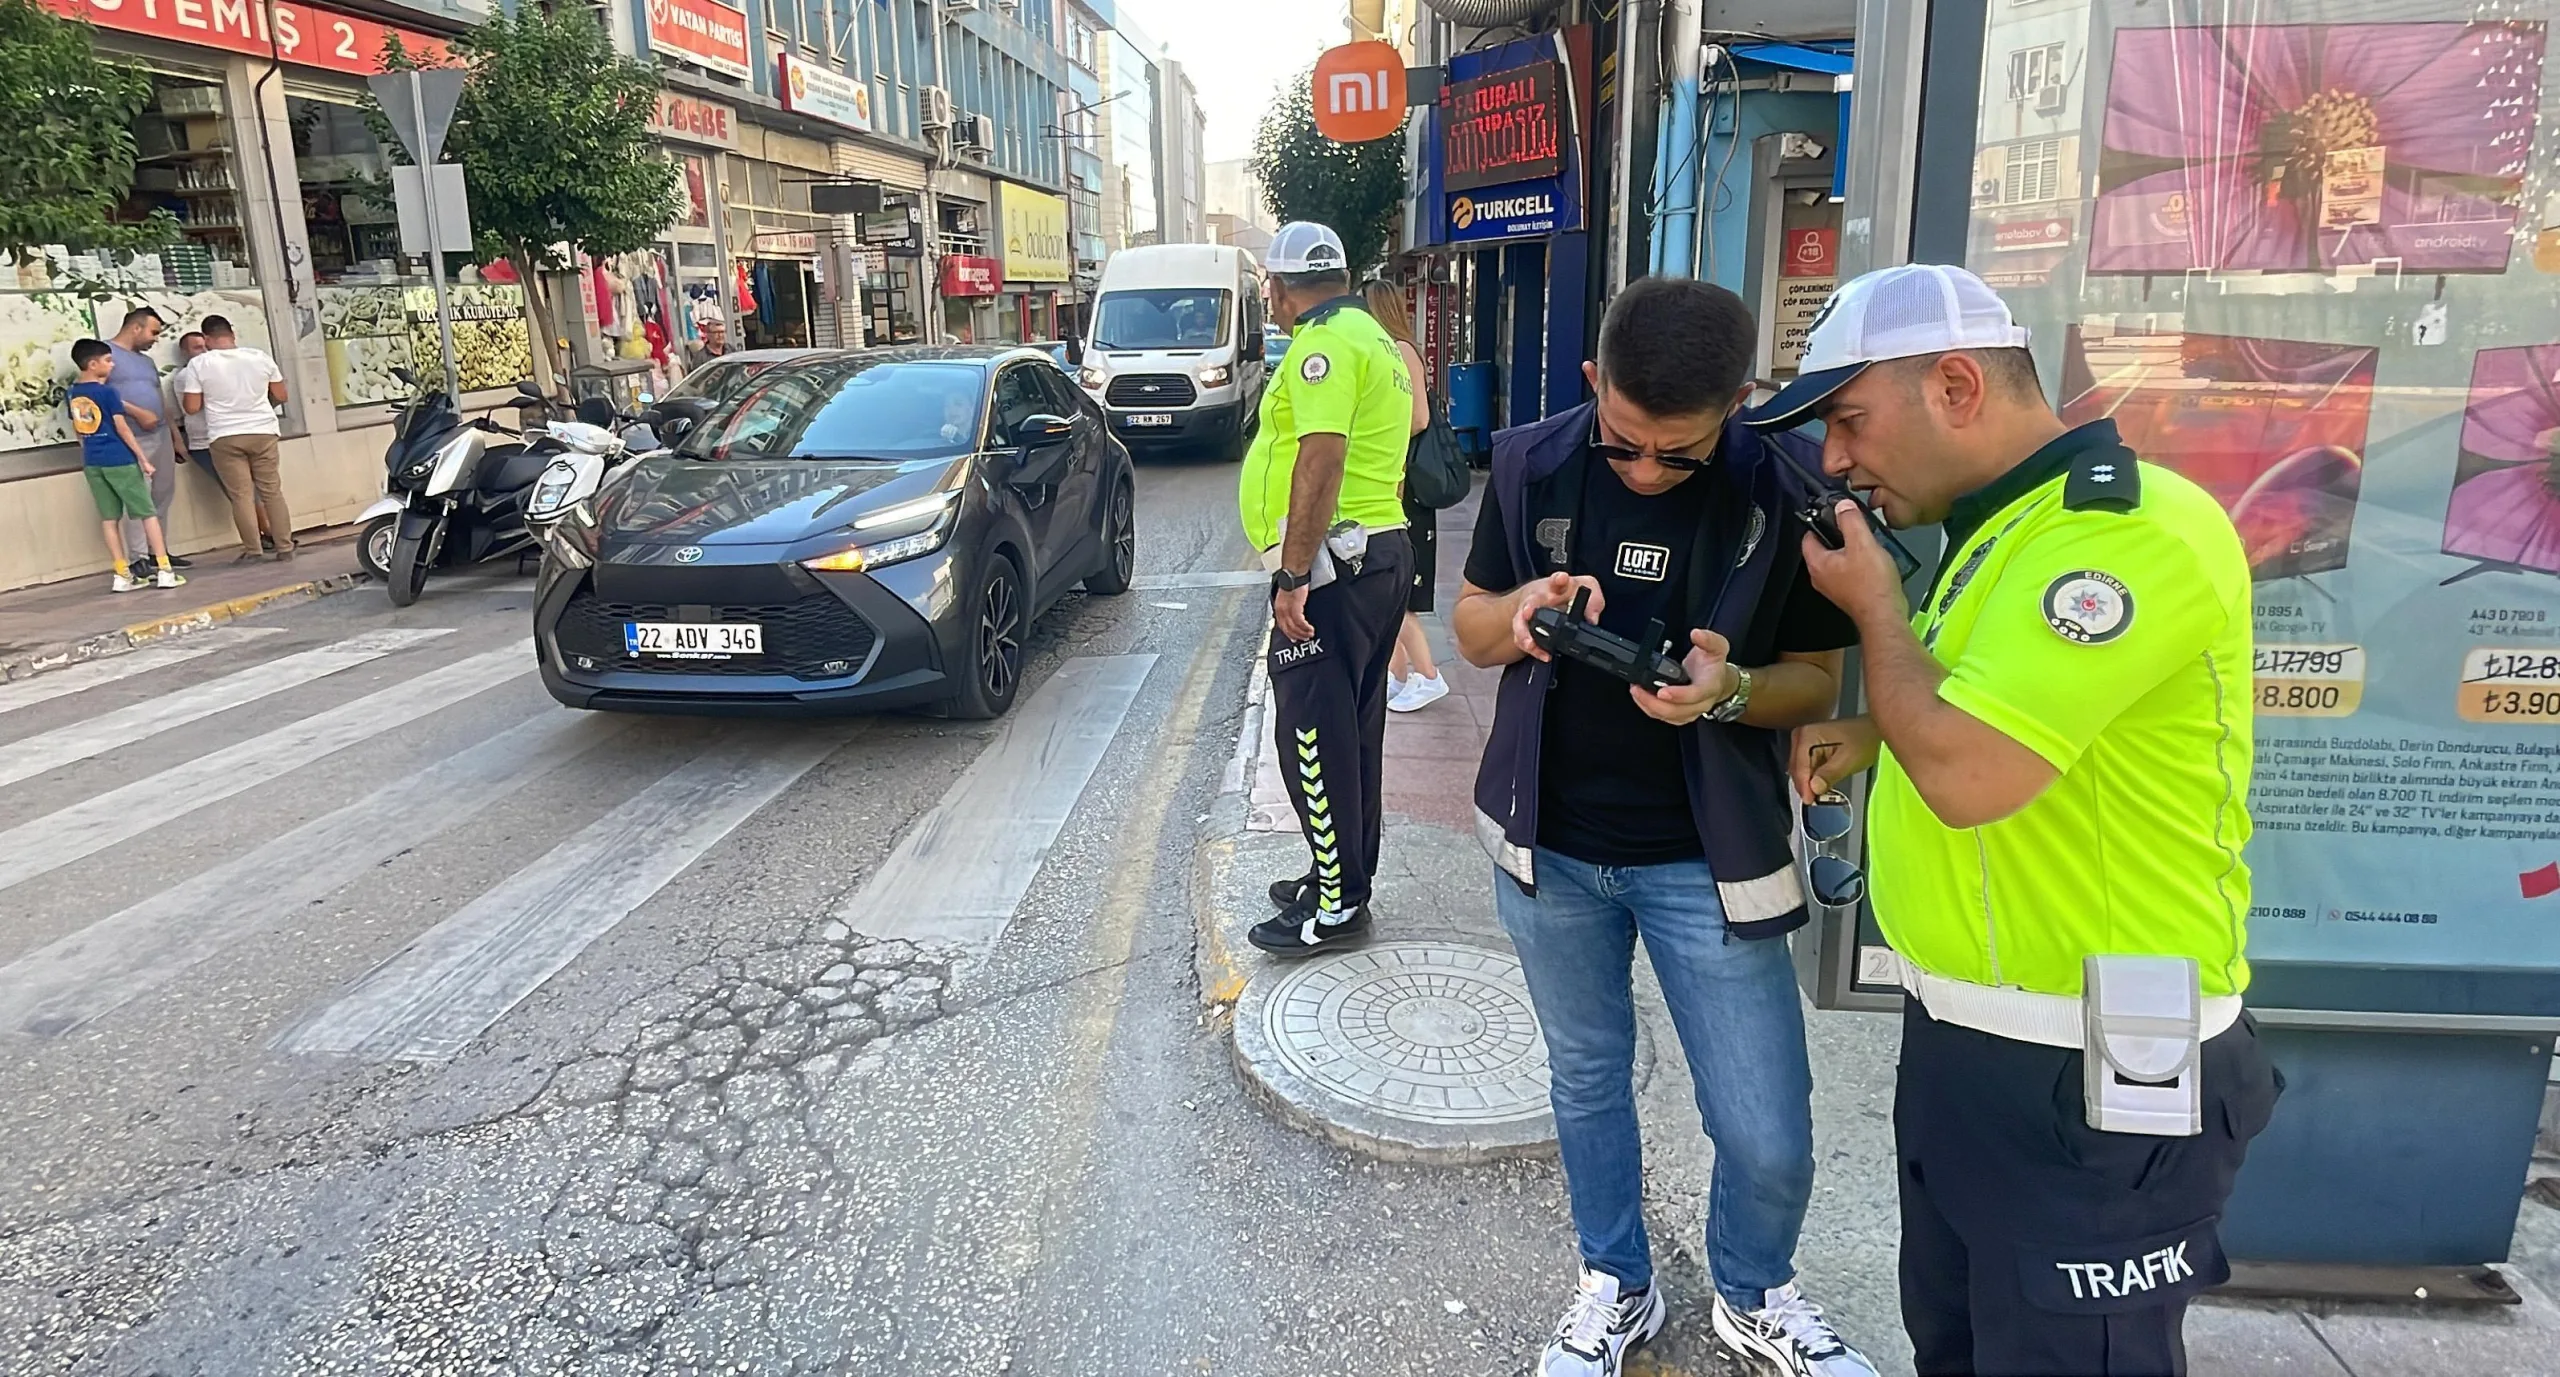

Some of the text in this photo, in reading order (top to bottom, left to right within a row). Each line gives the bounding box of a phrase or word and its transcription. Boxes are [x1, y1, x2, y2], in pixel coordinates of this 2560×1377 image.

[670, 4, 708, 36] VATAN
[332, 21, 359, 60] 2
[671, 98, 728, 140] BEBE
[1474, 194, 1555, 221] TURKCELL
[1783, 297, 1798, 308] ÇÖP
[2267, 606, 2292, 618] 895
[2295, 606, 2303, 618] A
[638, 627, 756, 650] 22 ADV 346
[2273, 737, 2327, 749] arasında
[2400, 739, 2434, 752] Derin
[2254, 752, 2271, 764] alı
[2274, 753, 2326, 768] Çamaşır
[2392, 756, 2420, 769] Solo
[2459, 758, 2517, 772] Ankastre
[2279, 769, 2288, 781] 4
[2291, 770, 2349, 784] tanesinin
[2352, 772, 2396, 785] birlikte
[2459, 774, 2498, 789] büyük
[2501, 776, 2537, 789] ekran
[2260, 786, 2304, 798] ürünün
[2307, 787, 2344, 799] bedeli
[2347, 788, 2375, 800] olan
[2378, 789, 2416, 802] 8.700
[2420, 790, 2434, 803] TL
[2438, 791, 2483, 804] indirim
[2487, 793, 2533, 808] seçilen
[2331, 803, 2346, 816] ile
[2375, 808, 2390, 818] ve
[2460, 809, 2541, 825] kampanyaya
[2253, 819, 2301, 831] masına
[2351, 821, 2369, 833] Bu
[2444, 825, 2477, 839] diğer
[2282, 907, 2306, 919] 888
[2377, 911, 2401, 923] 444
[1868, 952, 1889, 978] 2
